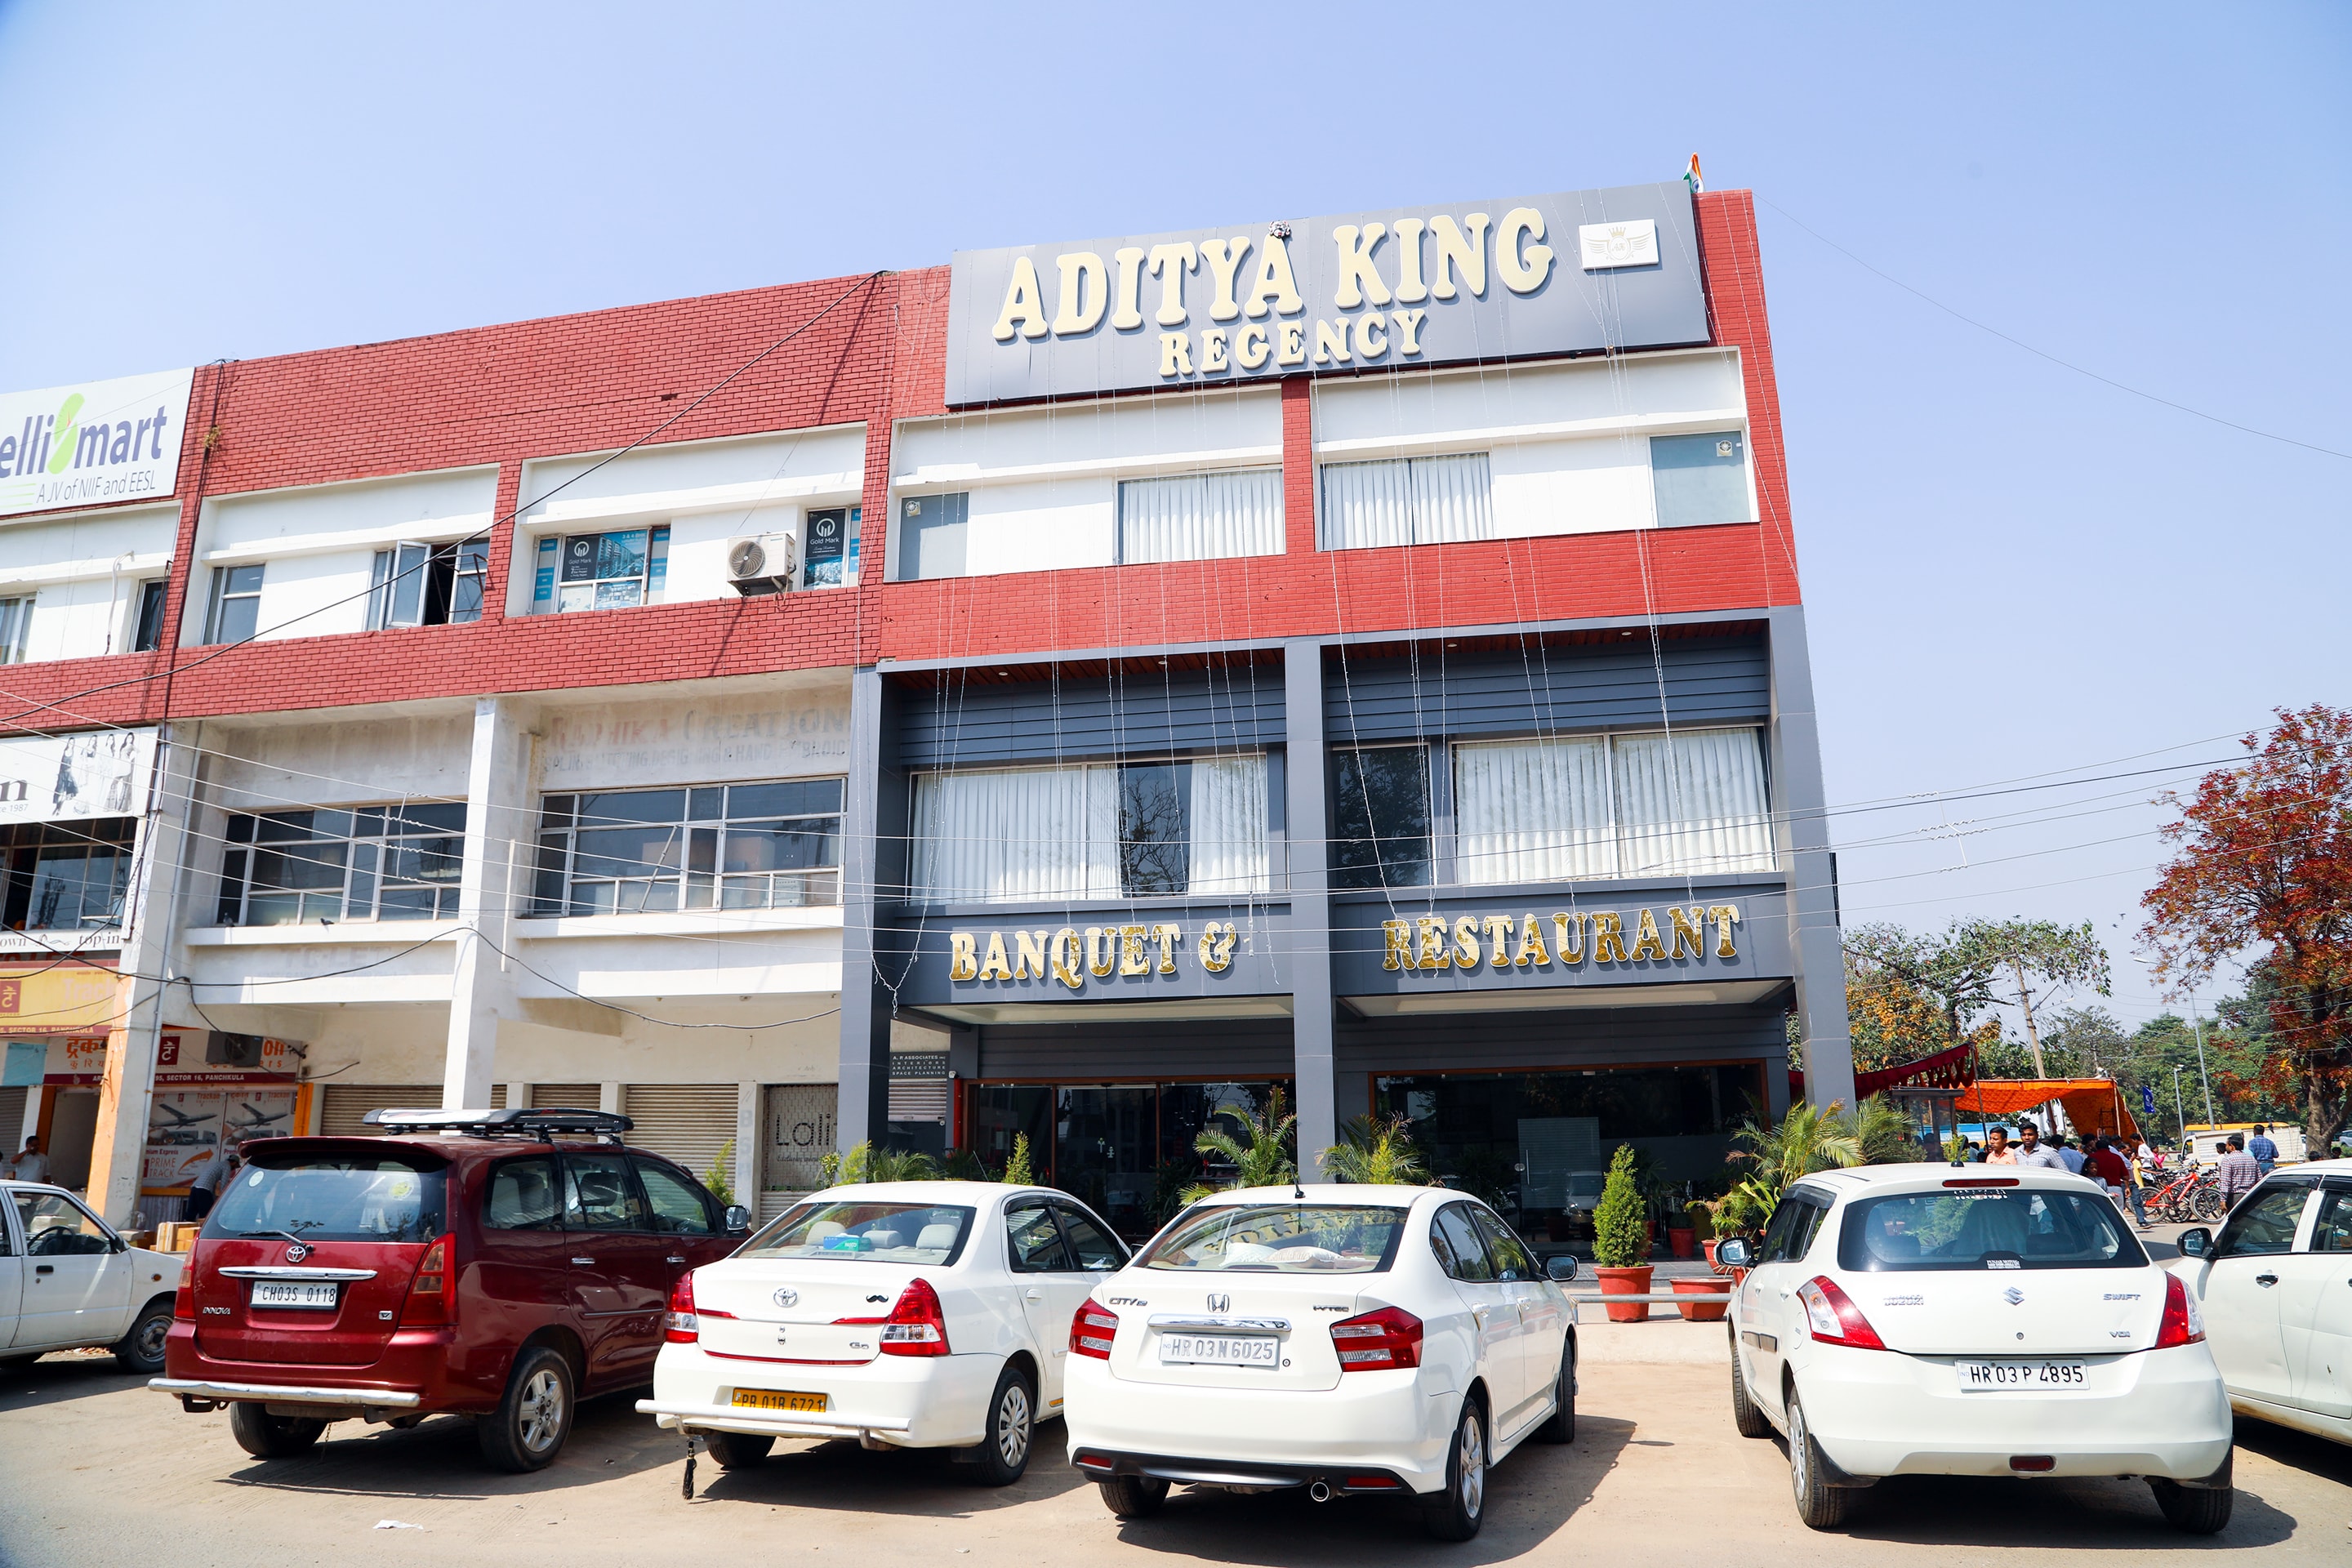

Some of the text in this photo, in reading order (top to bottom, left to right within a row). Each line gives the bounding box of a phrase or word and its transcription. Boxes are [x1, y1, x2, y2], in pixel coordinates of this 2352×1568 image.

[992, 207, 1553, 341] ADITYA KING
[1158, 308, 1426, 376] REGENCY
[36, 470, 156, 503] A JV of NIIF and EESL
[10, 804, 29, 813] 1987
[1380, 903, 1740, 971] RESTAURANT
[950, 921, 1237, 989] BANQUET &
[51, 1026, 94, 1034] PANCHKULA
[776, 1113, 837, 1146] Lali
[149, 1157, 176, 1168] PRIME
[148, 1169, 175, 1178] TRACK
[262, 1286, 336, 1303] CH03S 0118
[1108, 1297, 1138, 1306] CITY
[203, 1307, 231, 1315] INNOVA
[1231, 1342, 1274, 1361] 6025
[1970, 1365, 1991, 1383] HR
[1996, 1366, 2017, 1383] 03
[2023, 1366, 2032, 1383] P
[2039, 1365, 2083, 1383] 4895
